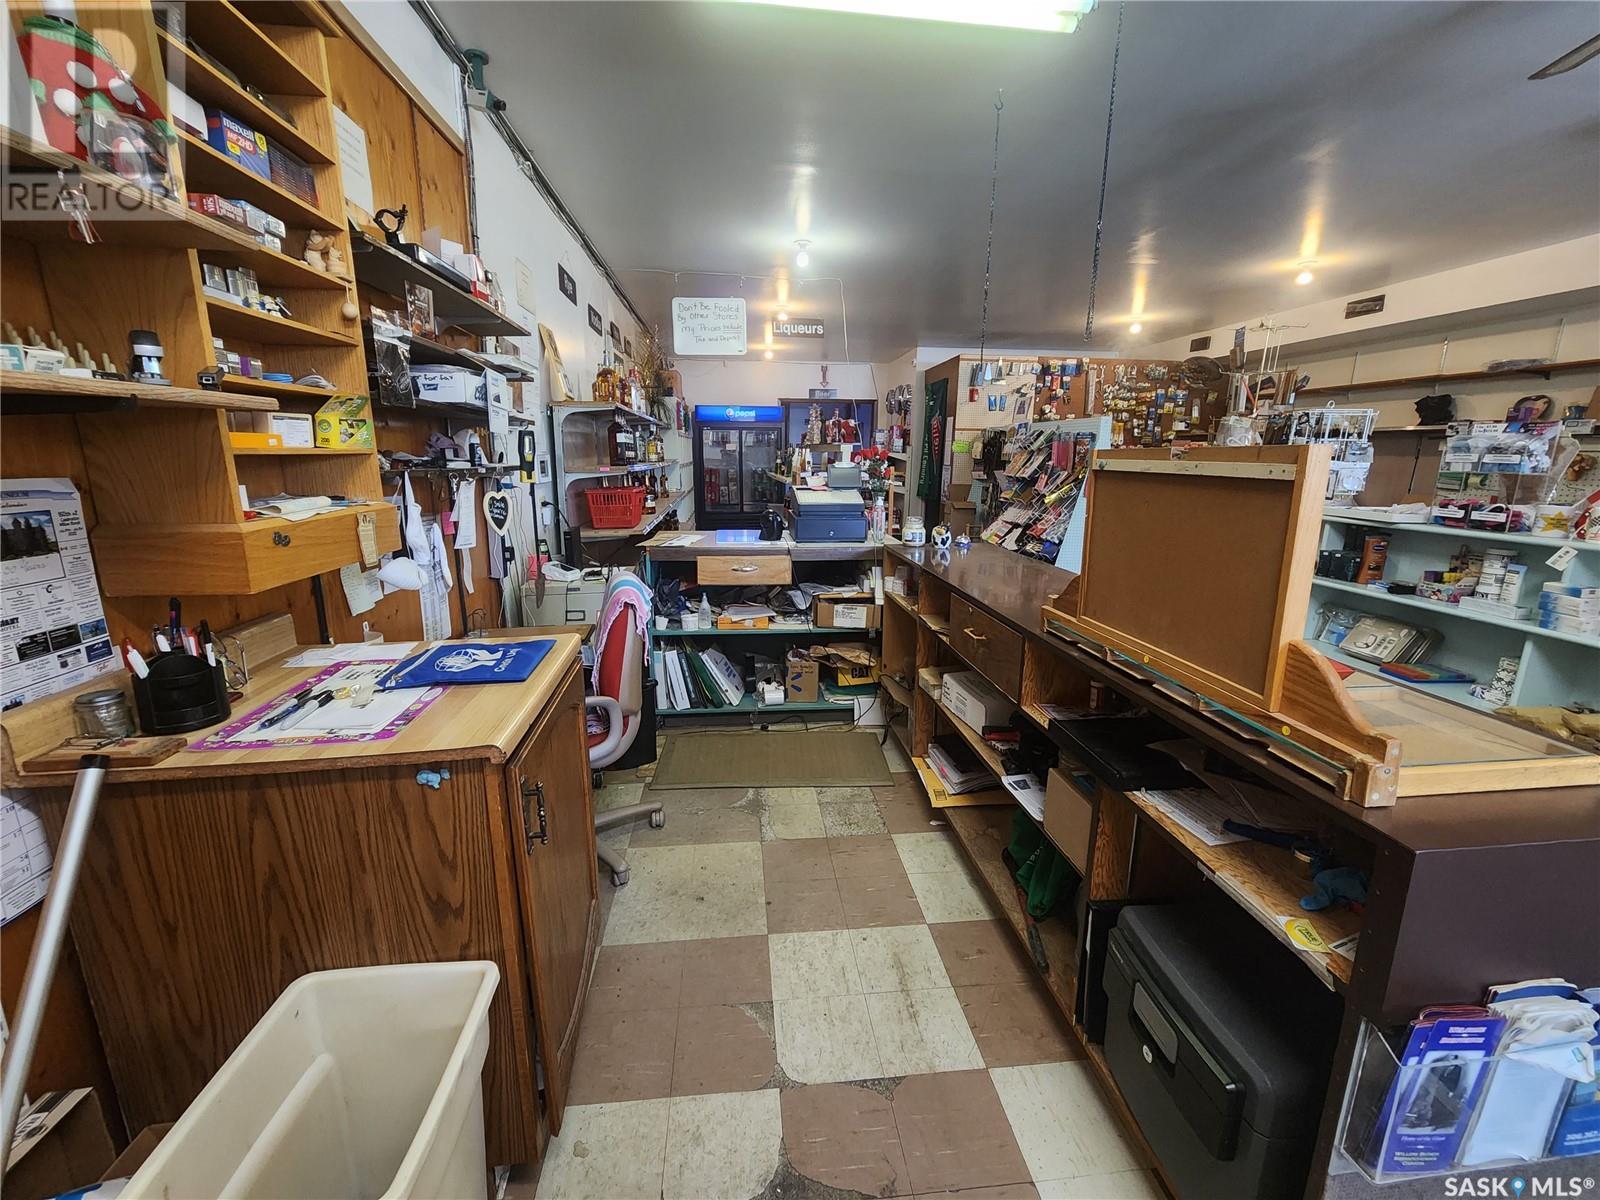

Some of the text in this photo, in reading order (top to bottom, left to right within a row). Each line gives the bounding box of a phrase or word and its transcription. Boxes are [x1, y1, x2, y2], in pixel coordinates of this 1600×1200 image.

[223, 119, 255, 141] maxell
[678, 302, 739, 313] Don't Be Fooled
[774, 321, 824, 336] Liqueurs
[735, 410, 756, 418] pepsi
[852, 667, 869, 679] CAT
